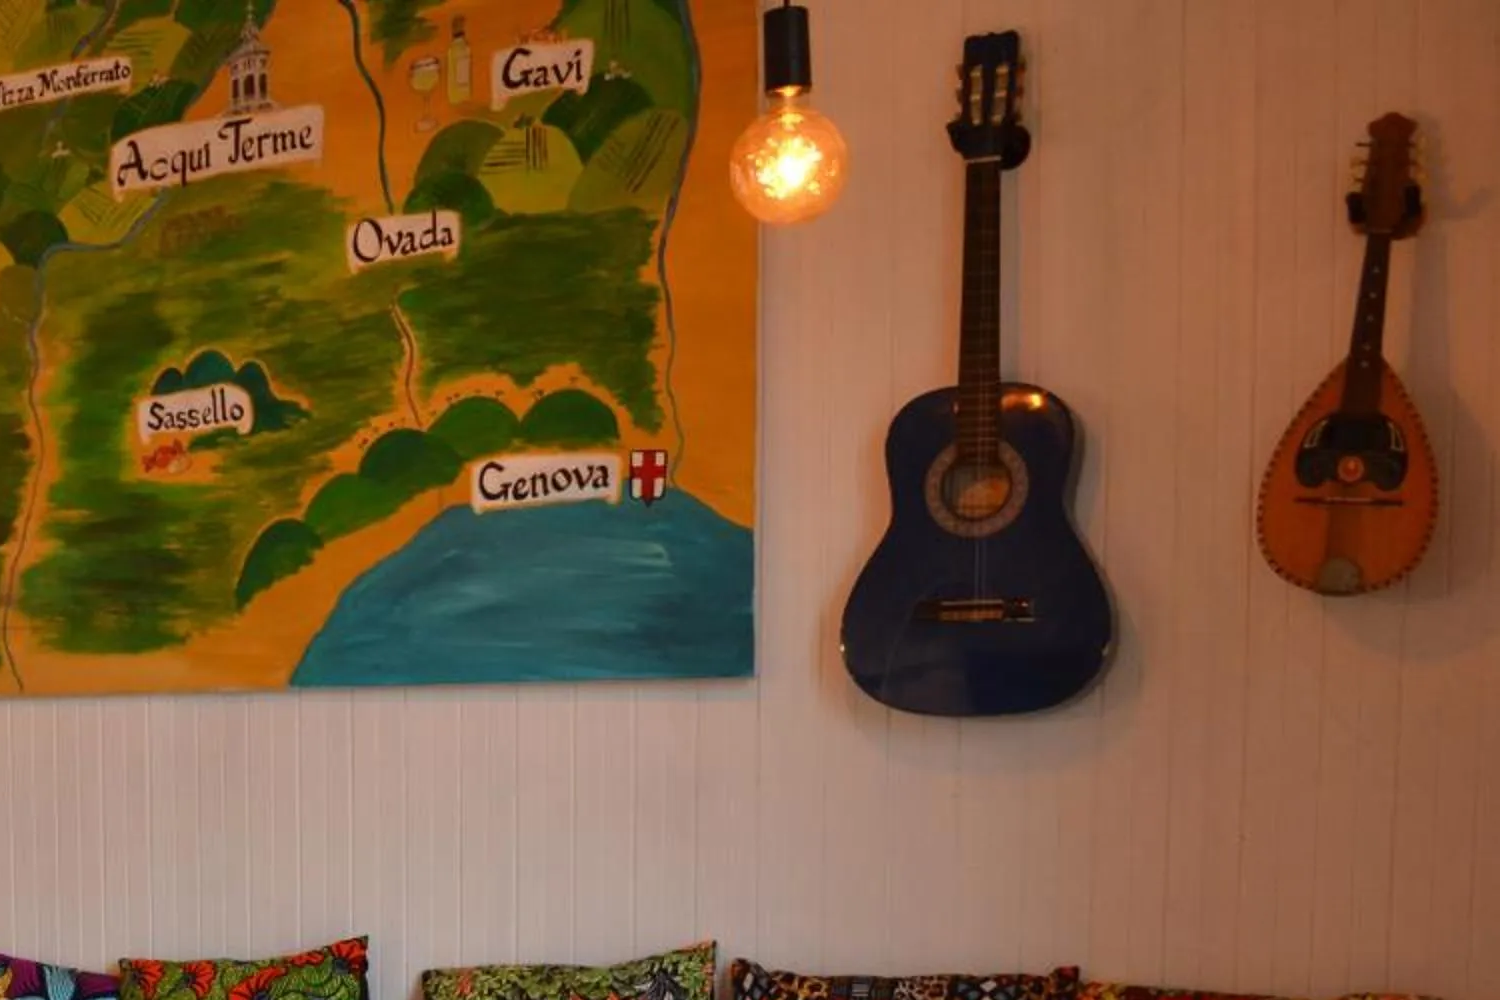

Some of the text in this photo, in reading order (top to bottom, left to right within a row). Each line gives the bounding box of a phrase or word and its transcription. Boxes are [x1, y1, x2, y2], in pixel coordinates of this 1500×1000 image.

[38, 62, 131, 97] Monferrato
[501, 47, 584, 90] Gavi
[116, 117, 314, 187] Acqui Terme
[352, 210, 454, 263] Ovada
[147, 387, 244, 432] Sassello
[478, 459, 611, 501] Genova
